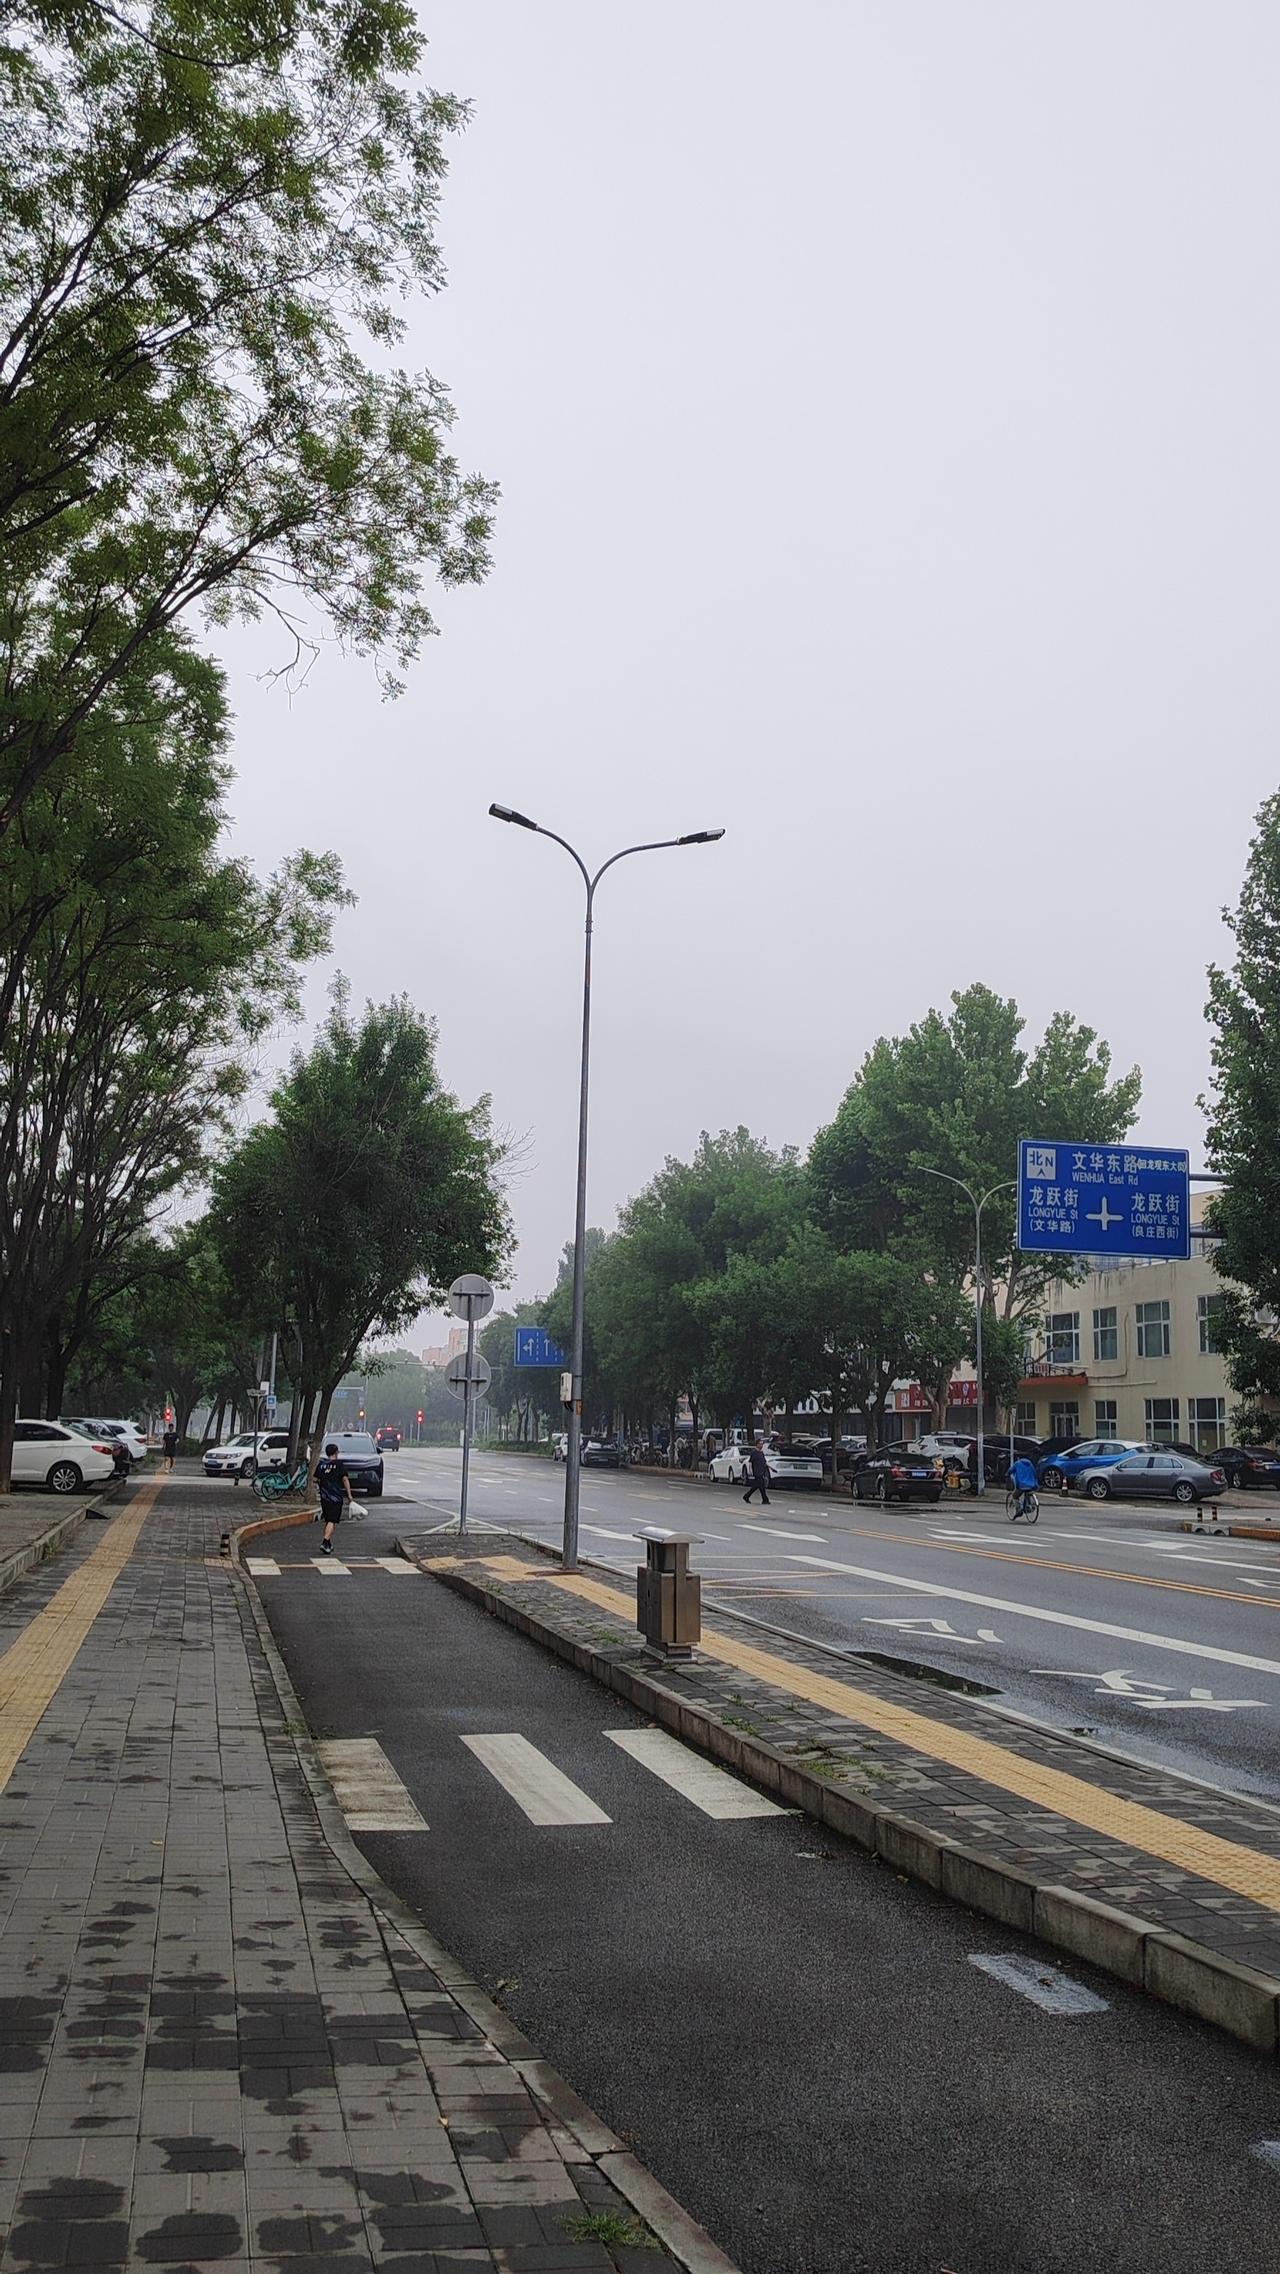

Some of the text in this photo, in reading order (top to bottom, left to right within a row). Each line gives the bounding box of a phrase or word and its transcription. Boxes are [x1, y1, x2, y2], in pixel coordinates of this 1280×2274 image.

[1029, 1150, 1053, 1167] 北 N
[1072, 1151, 1137, 1174] 文华东路
[1072, 1172, 1139, 1186] WENHUA East Rd
[1029, 1187, 1079, 1208] 龙跃街
[1131, 1192, 1180, 1213] 龙跃街
[1028, 1206, 1079, 1220] LONGYUE St
[1131, 1213, 1180, 1226] LONGYUE St
